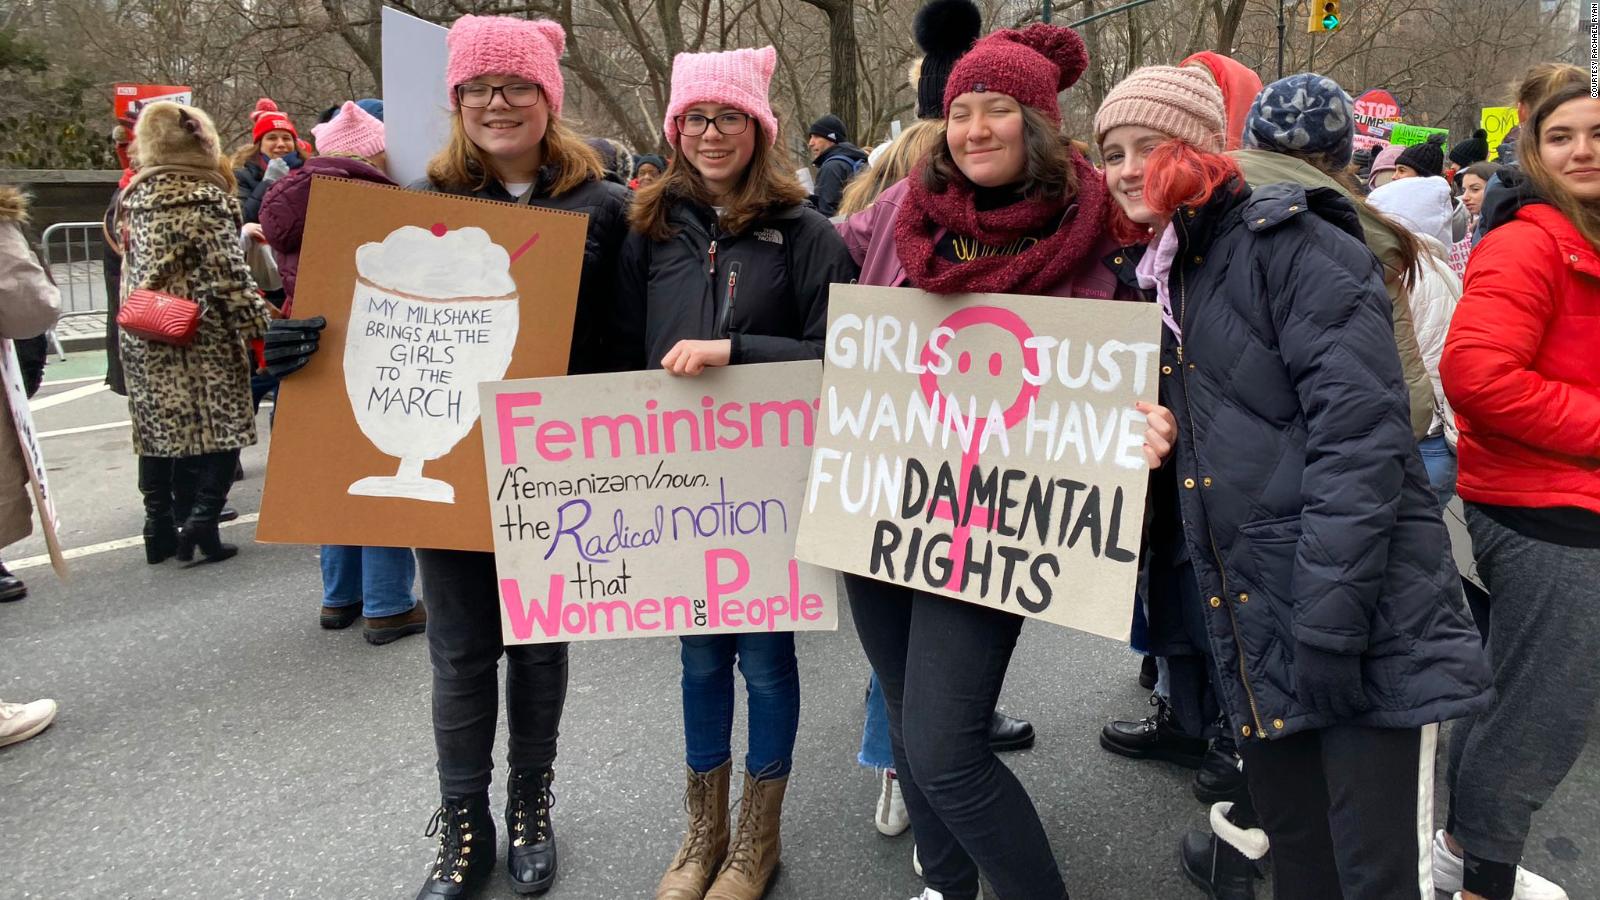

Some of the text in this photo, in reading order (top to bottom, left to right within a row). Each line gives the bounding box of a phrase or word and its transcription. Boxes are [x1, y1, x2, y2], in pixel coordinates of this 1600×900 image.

[1354, 100, 1397, 119] STOP
[365, 320, 491, 344] BRINGS ALL THE
[368, 297, 492, 326] MY MILKSHAKE
[375, 366, 453, 384] TO THE
[390, 344, 455, 366] GIRLS
[826, 313, 1160, 396] GIRLS JUST
[368, 386, 462, 424] MARCH
[828, 385, 1148, 470] WANNA HAVE
[500, 477, 787, 563] the Radical notion
[809, 447, 1137, 564] FUNDAMENTAL
[570, 558, 632, 599] that
[869, 519, 1060, 613] RIGHTS
[500, 548, 823, 640] Women are People
